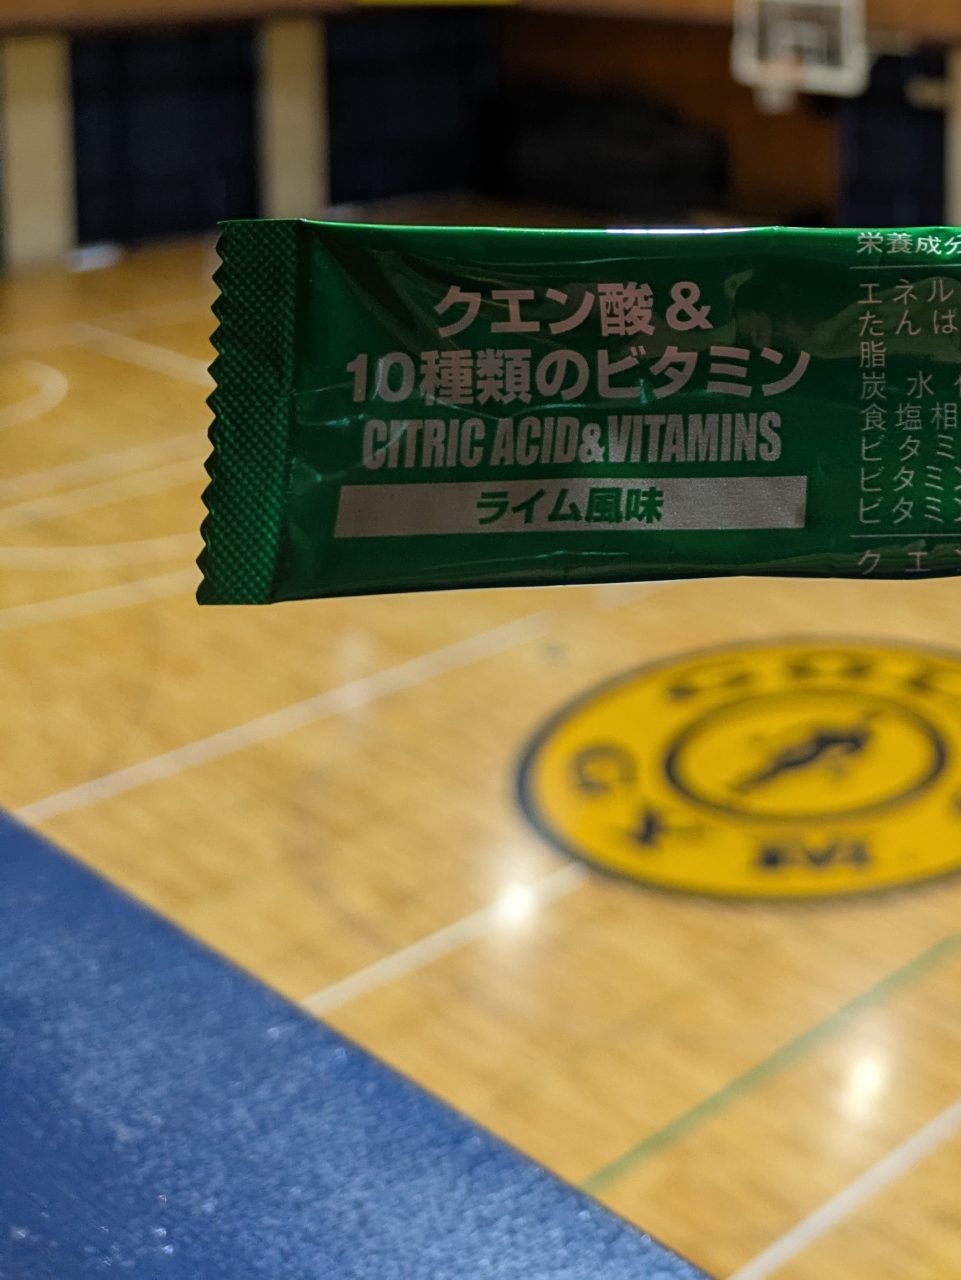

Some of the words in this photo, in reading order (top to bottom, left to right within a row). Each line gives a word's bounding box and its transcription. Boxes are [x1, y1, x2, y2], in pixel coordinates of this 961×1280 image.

[346, 345, 811, 407] 10種類のビタミン
[362, 419, 485, 470] CITRIC
[489, 411, 782, 466] ACID&VITAMINS
[477, 487, 664, 525] ライム風味
